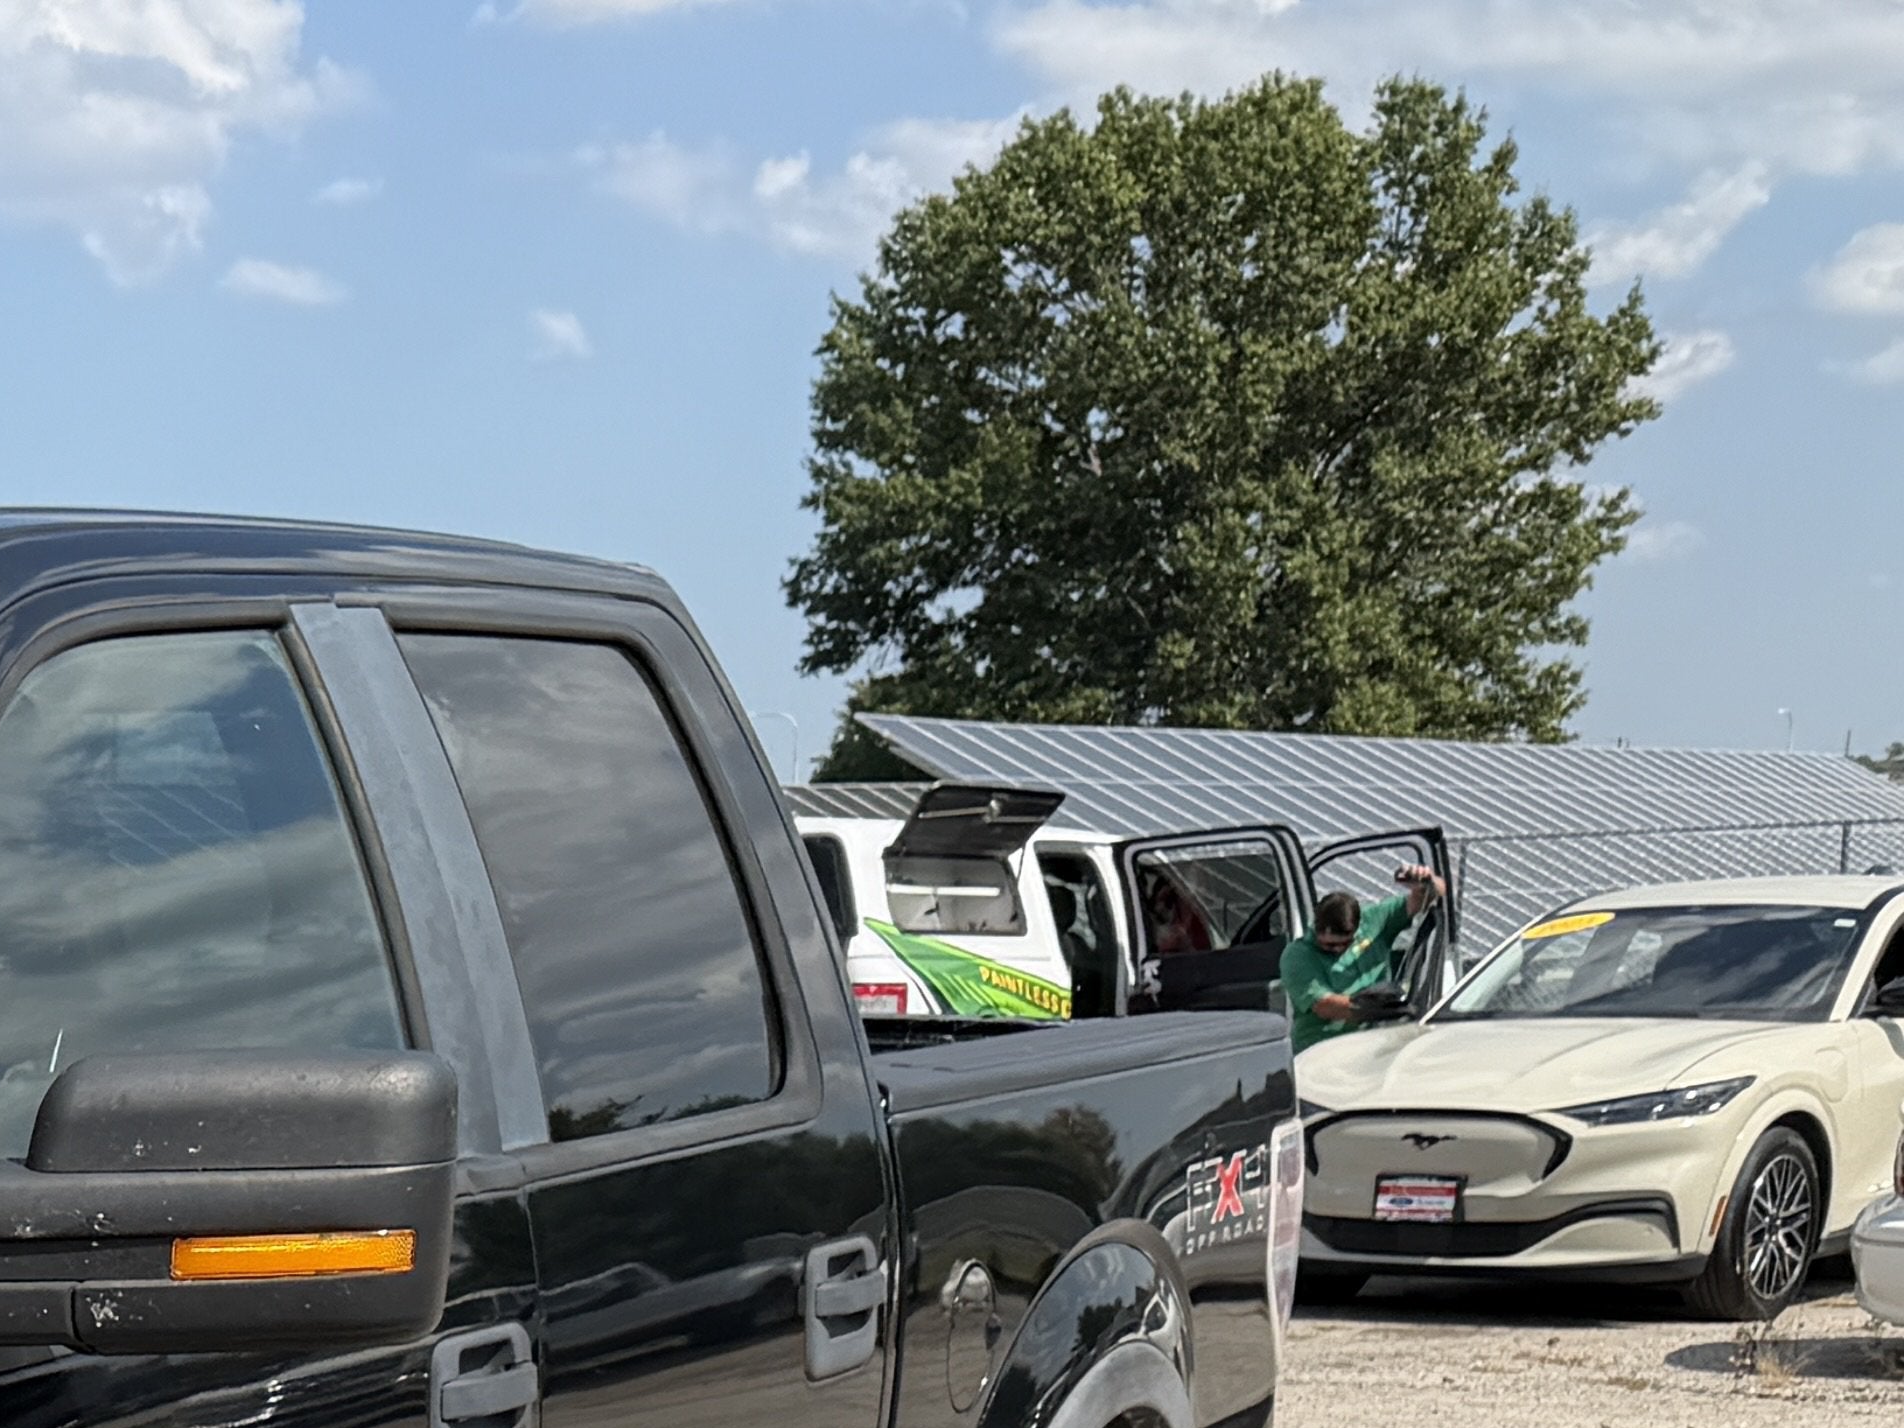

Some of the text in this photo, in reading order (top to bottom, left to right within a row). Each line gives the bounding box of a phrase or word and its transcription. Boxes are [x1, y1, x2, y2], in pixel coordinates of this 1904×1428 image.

[978, 965, 1060, 1014] PAINTLESS
[1186, 1144, 1266, 1232] FX4
[1185, 1230, 1217, 1256] OFF
